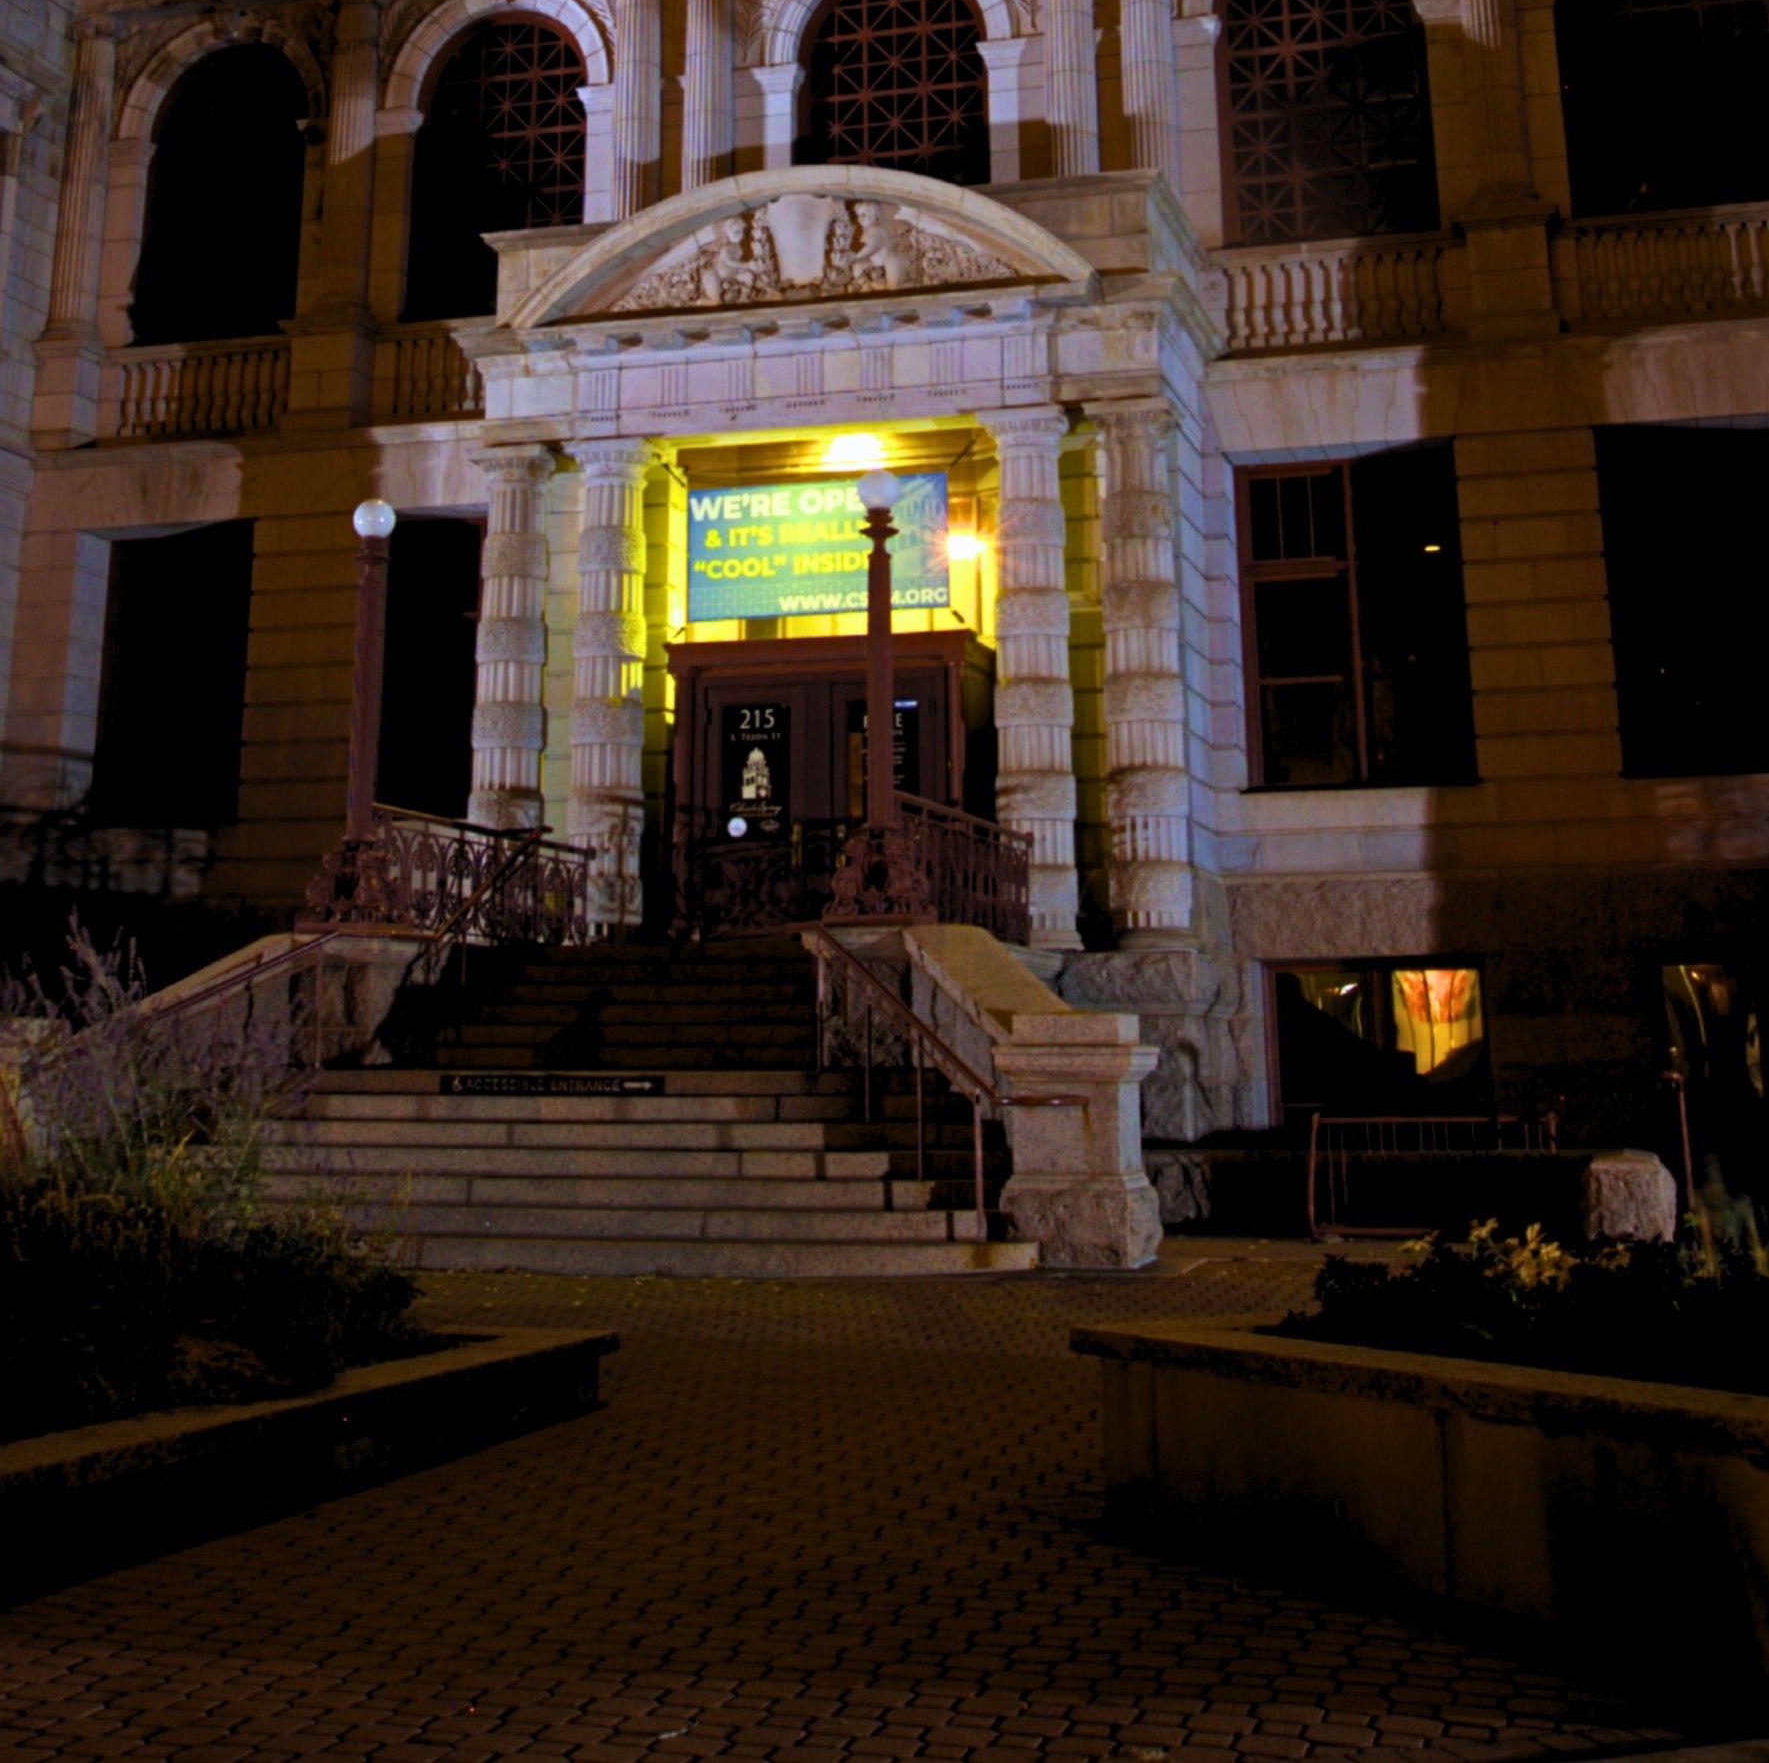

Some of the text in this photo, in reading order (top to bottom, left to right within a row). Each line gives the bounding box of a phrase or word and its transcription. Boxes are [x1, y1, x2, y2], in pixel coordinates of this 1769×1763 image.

[690, 487, 864, 521] WE'RE OPE
[705, 529, 722, 548] &
[729, 524, 773, 547] IT'S
[779, 587, 948, 612] WWW.CS.ORG
[740, 709, 775, 729] 215
[465, 1077, 545, 1092] ACCESSIBLE
